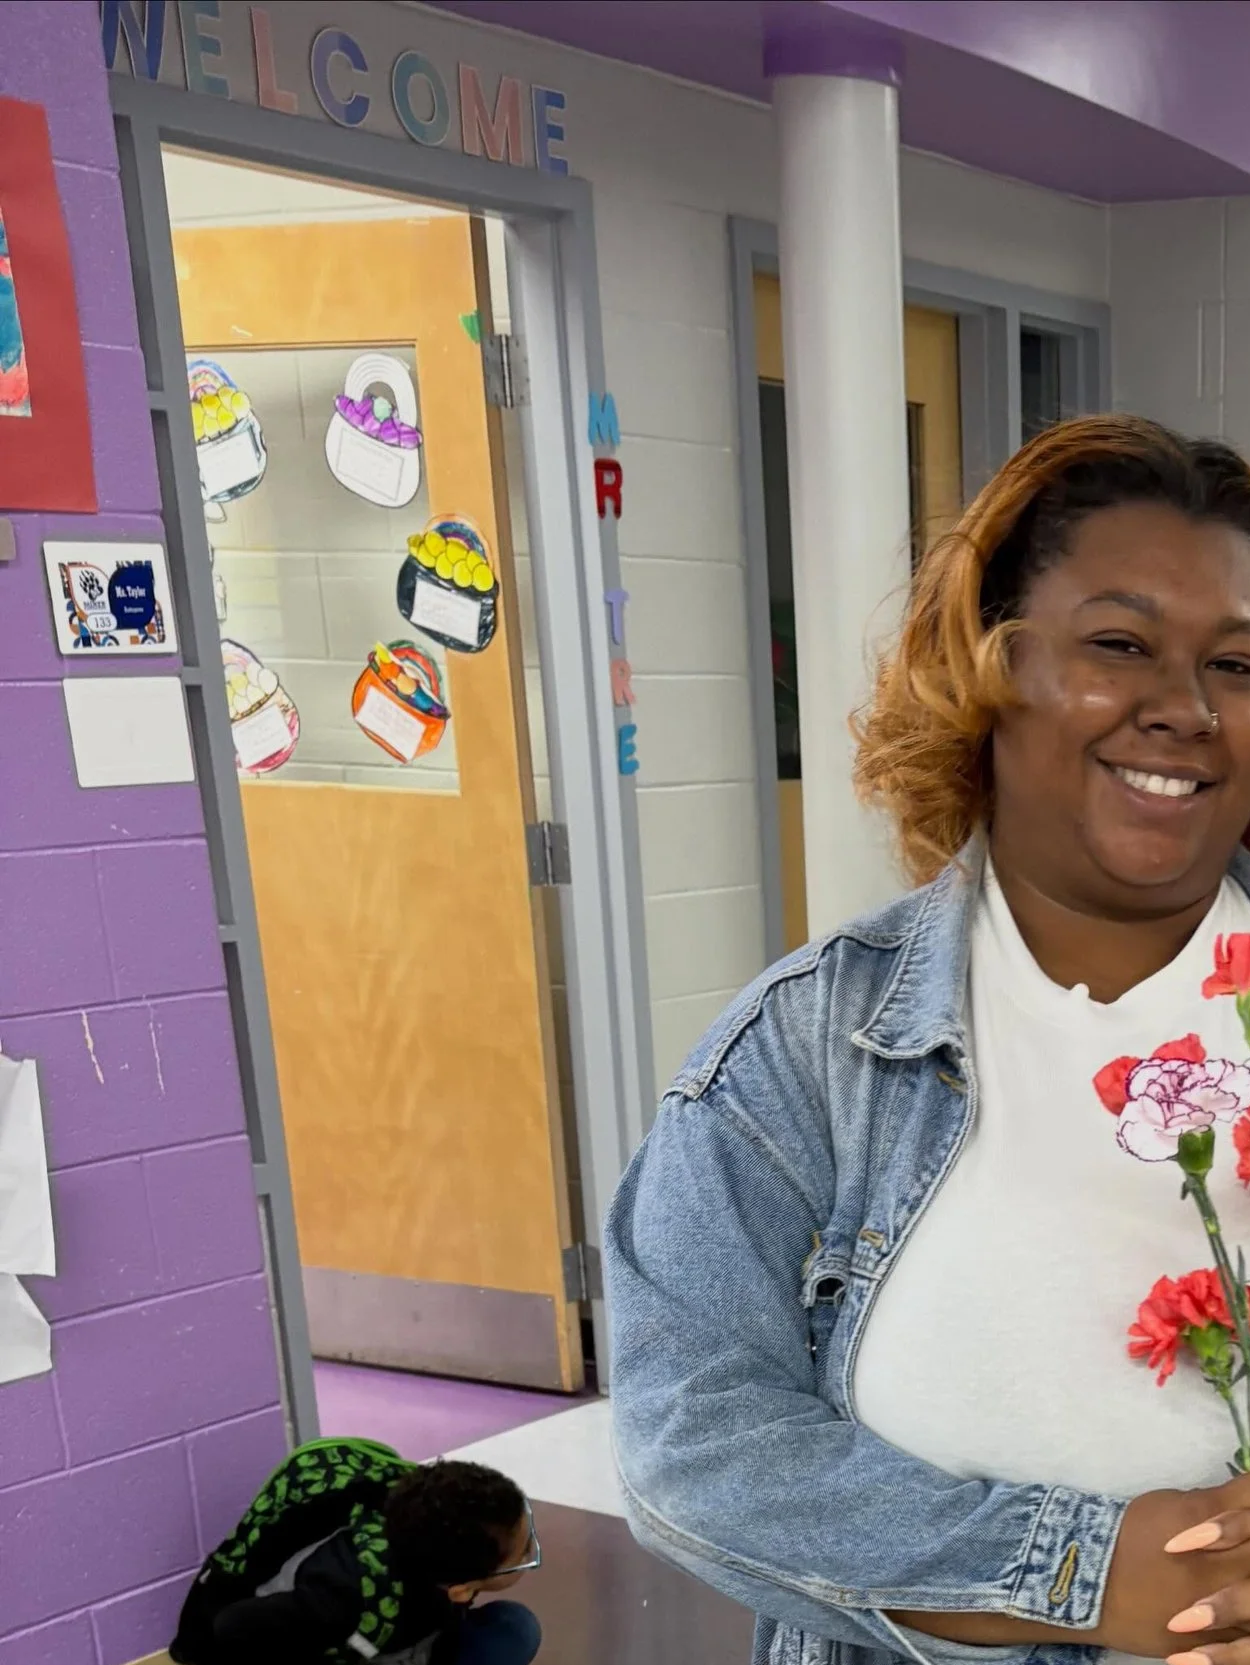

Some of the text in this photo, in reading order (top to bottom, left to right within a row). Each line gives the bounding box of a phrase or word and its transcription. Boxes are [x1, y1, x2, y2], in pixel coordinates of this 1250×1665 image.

[102, 0, 570, 176] WELCOME
[126, 585, 146, 599] Taylor
[94, 617, 112, 628] 133
